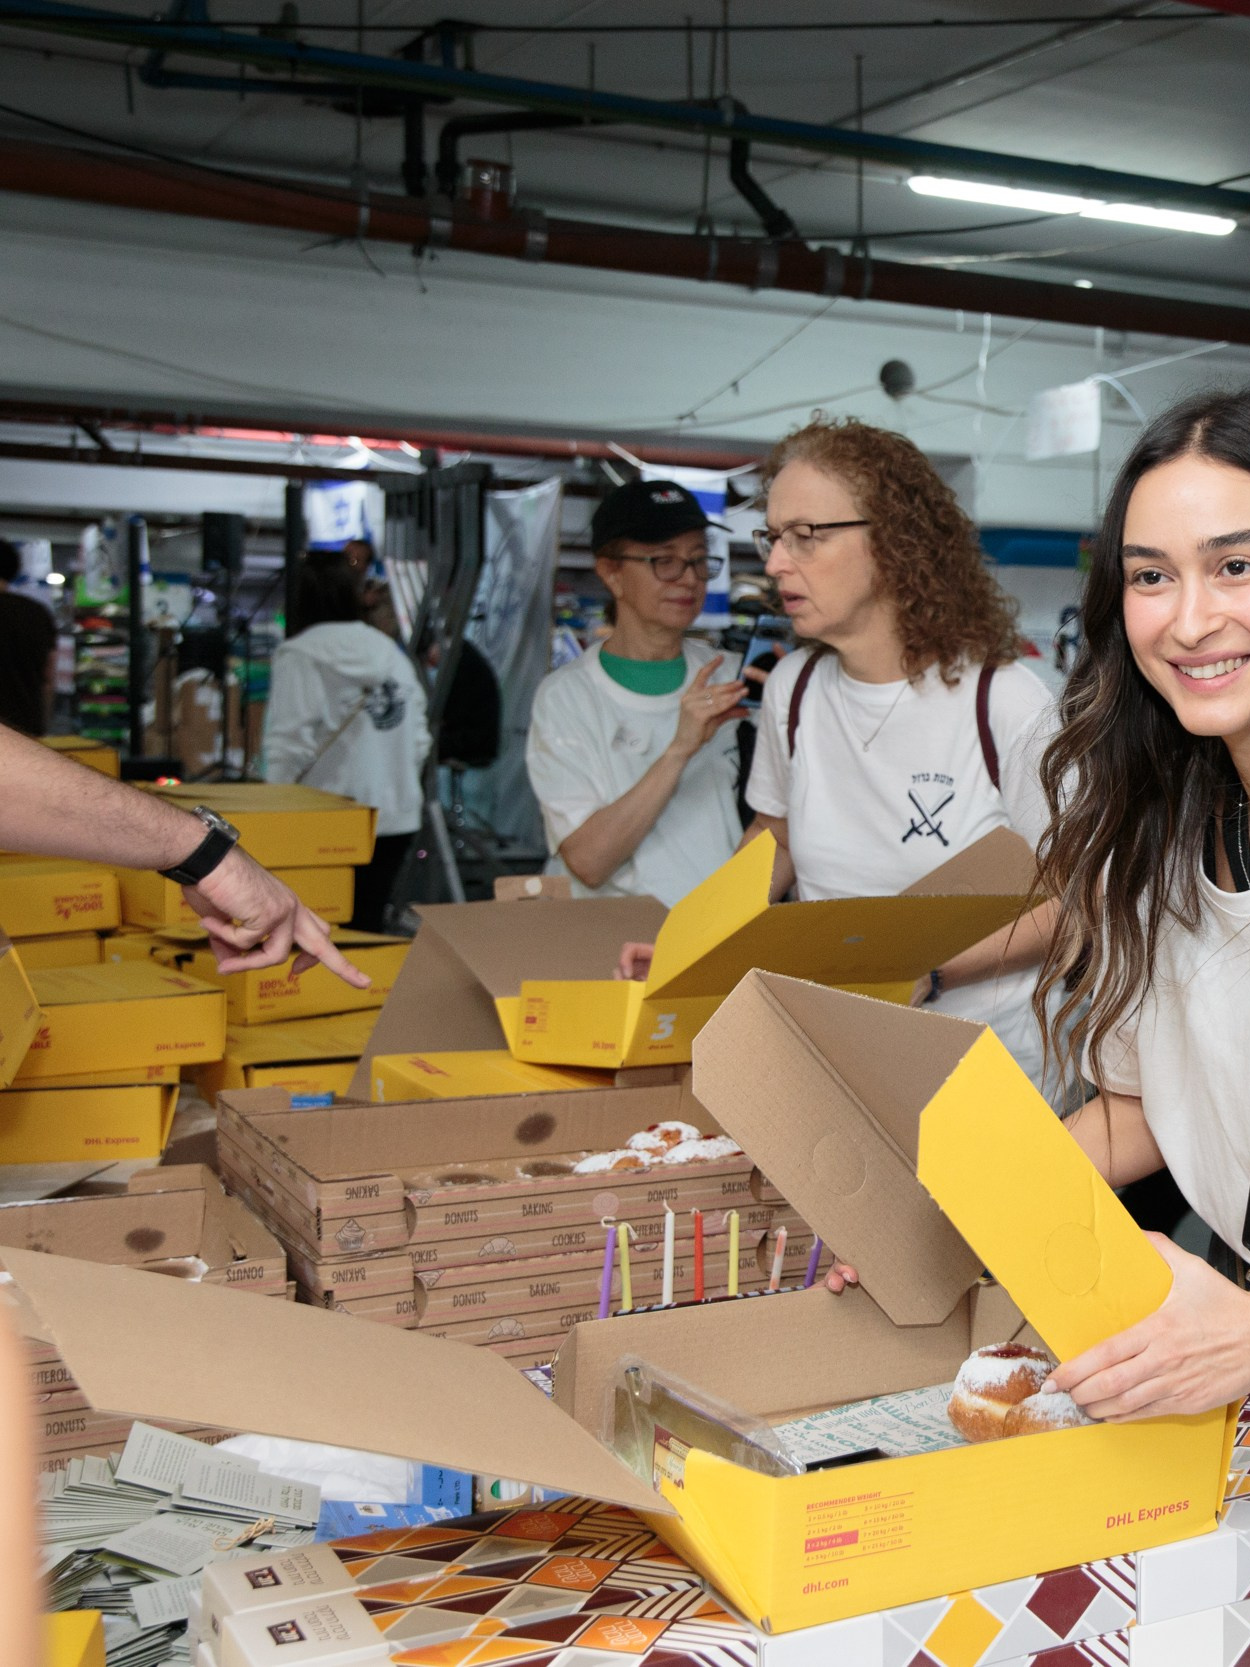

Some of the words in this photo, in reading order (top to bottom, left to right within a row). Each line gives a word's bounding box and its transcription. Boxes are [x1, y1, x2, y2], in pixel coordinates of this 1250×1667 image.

[346, 1184, 380, 1200] BAKING
[444, 1210, 479, 1225] DONUTS
[522, 1202, 554, 1217] BAKING
[648, 1188, 679, 1202] DONUTS
[721, 1180, 750, 1195] BAKING
[552, 1232, 586, 1247] COOKIES
[225, 1266, 264, 1282] DONUTS
[332, 1267, 366, 1284] BAKING
[452, 1291, 487, 1307] DONUTS
[529, 1281, 561, 1297] BAKING
[45, 1417, 87, 1437] DONUTS
[806, 1496, 856, 1510] RECOMMENDED
[857, 1491, 882, 1501] WEIGHT
[1105, 1511, 1135, 1529] DHL
[1137, 1500, 1190, 1521] Express
[802, 1577, 849, 1595] dhl.com
